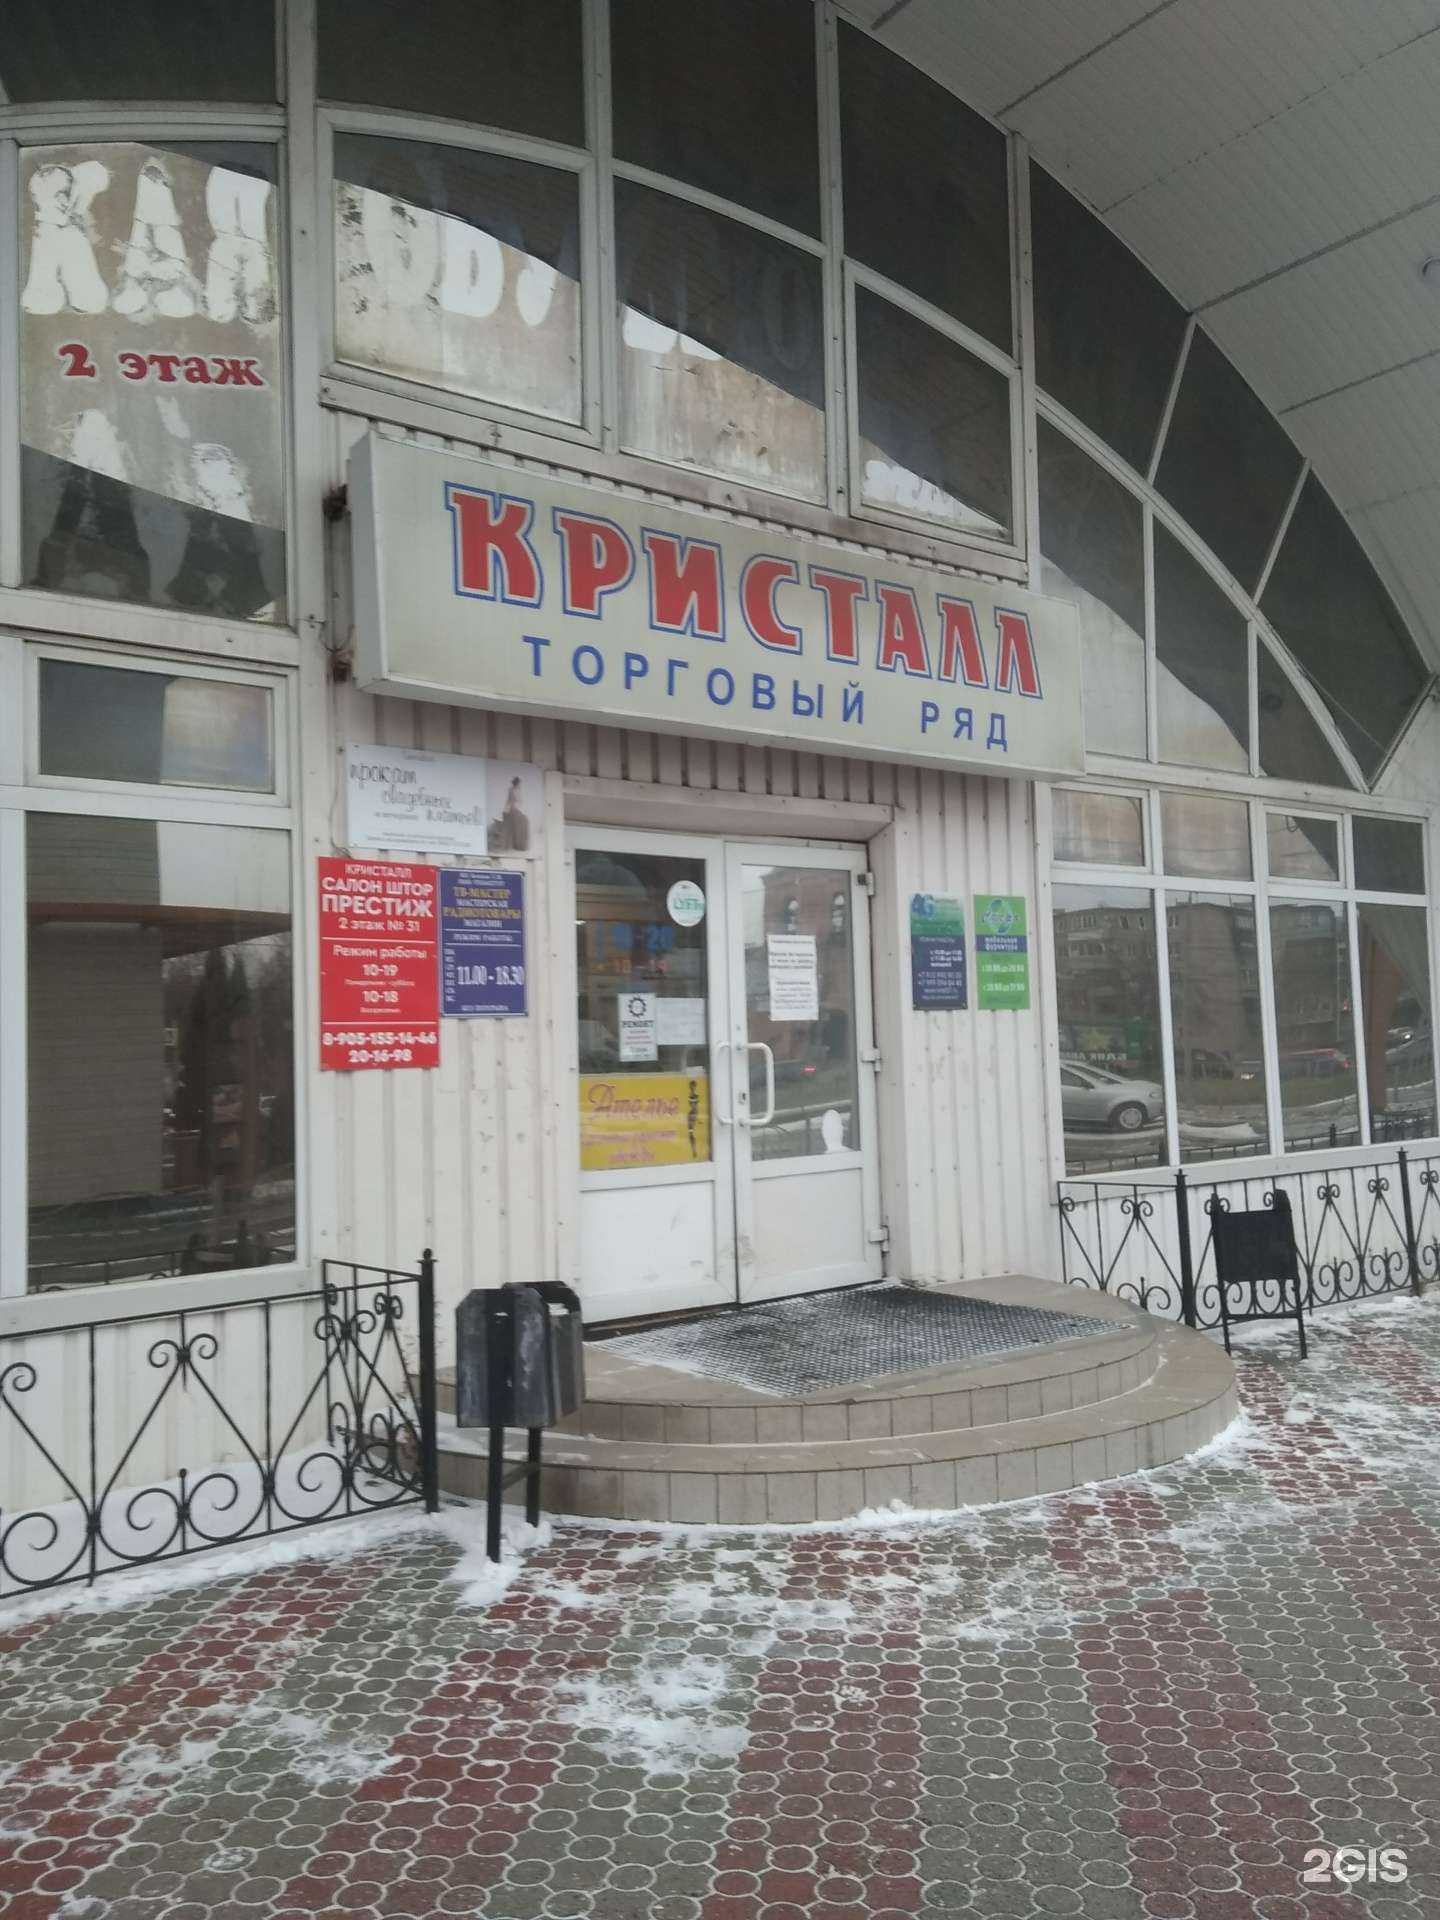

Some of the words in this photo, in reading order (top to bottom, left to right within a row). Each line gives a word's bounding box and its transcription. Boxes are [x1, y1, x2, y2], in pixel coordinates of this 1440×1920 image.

[58, 343, 97, 379] 2
[117, 351, 266, 388] этаж
[444, 481, 1043, 701] КРИСТАЛЛ
[522, 635, 865, 726] ТОРГОВЫЙ
[920, 700, 1009, 753] РЯД
[321, 877, 383, 894] САЛОН
[386, 881, 434, 898] ШТОР
[321, 894, 434, 918] ПРЕСТИЖ
[338, 917, 348, 931] 2
[350, 919, 385, 931] этаж
[333, 945, 378, 958] Режим
[379, 945, 427, 960] работы
